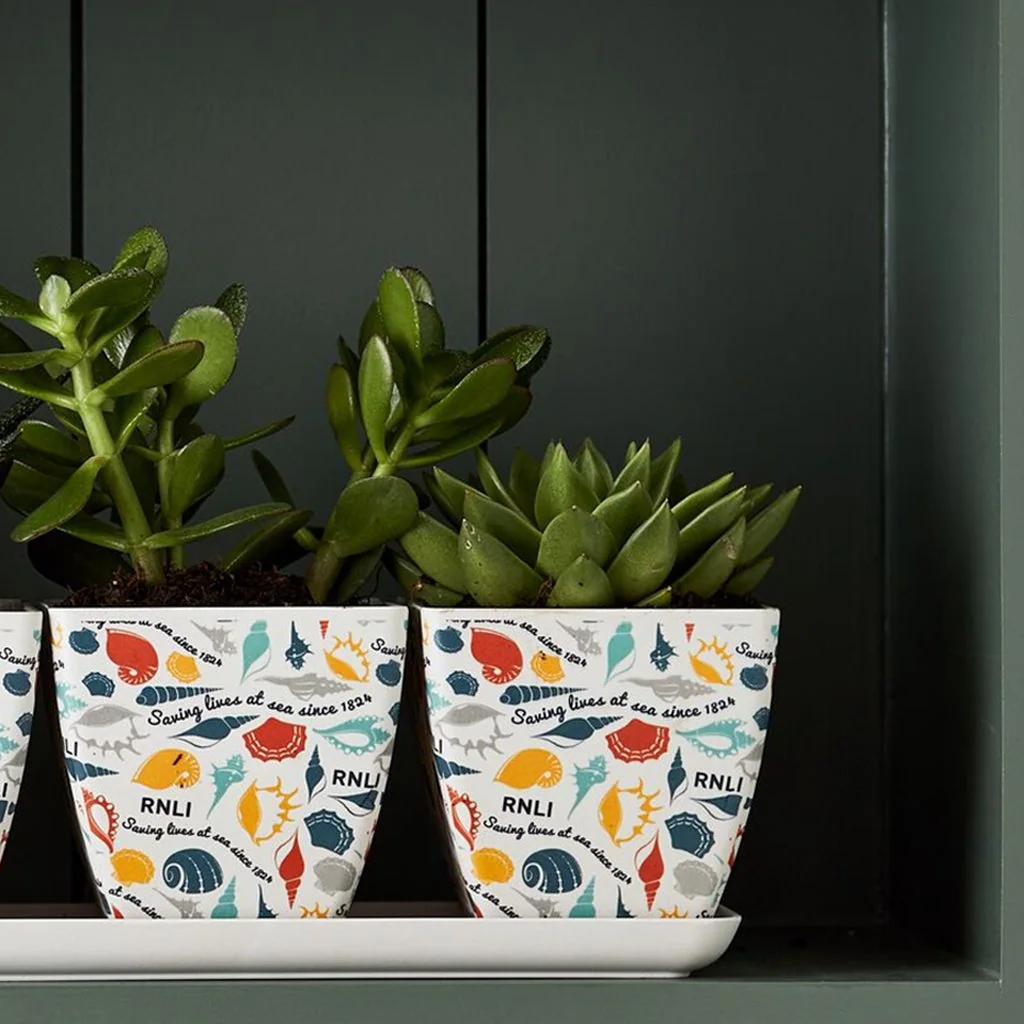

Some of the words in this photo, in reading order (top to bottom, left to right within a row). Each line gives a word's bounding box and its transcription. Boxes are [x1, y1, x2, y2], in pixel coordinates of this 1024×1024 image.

[154, 622, 173, 637] sea
[172, 636, 198, 656] since
[199, 652, 223, 667] 1824
[519, 622, 538, 637] sea
[538, 635, 563, 656] since
[563, 652, 587, 668] 1824
[147, 707, 204, 725] Saving
[204, 694, 243, 711] lives
[246, 690, 265, 706] at
[266, 701, 294, 715] sea
[298, 703, 339, 717] since
[340, 693, 372, 712] 1824
[510, 707, 567, 726] Saving
[568, 694, 607, 712] lives
[609, 691, 629, 707] at
[630, 702, 658, 717] sea
[661, 705, 702, 719] since
[704, 696, 736, 715] 1824
[332, 769, 381, 789] RNLI
[693, 771, 744, 793] RNLI
[140, 796, 192, 818] RNLI
[502, 796, 553, 818] RNLI
[121, 816, 165, 841] Saving
[166, 821, 195, 837] lives
[196, 826, 212, 838] at
[212, 834, 231, 849] sea
[229, 847, 253, 869] since
[251, 866, 273, 884] 1824
[482, 815, 526, 841] Saving
[527, 821, 556, 836] lives
[557, 826, 573, 839] at
[572, 834, 592, 849] sea
[590, 848, 612, 869] since
[610, 867, 632, 885] 1824
[123, 893, 142, 908] sea
[481, 892, 500, 906] sea
